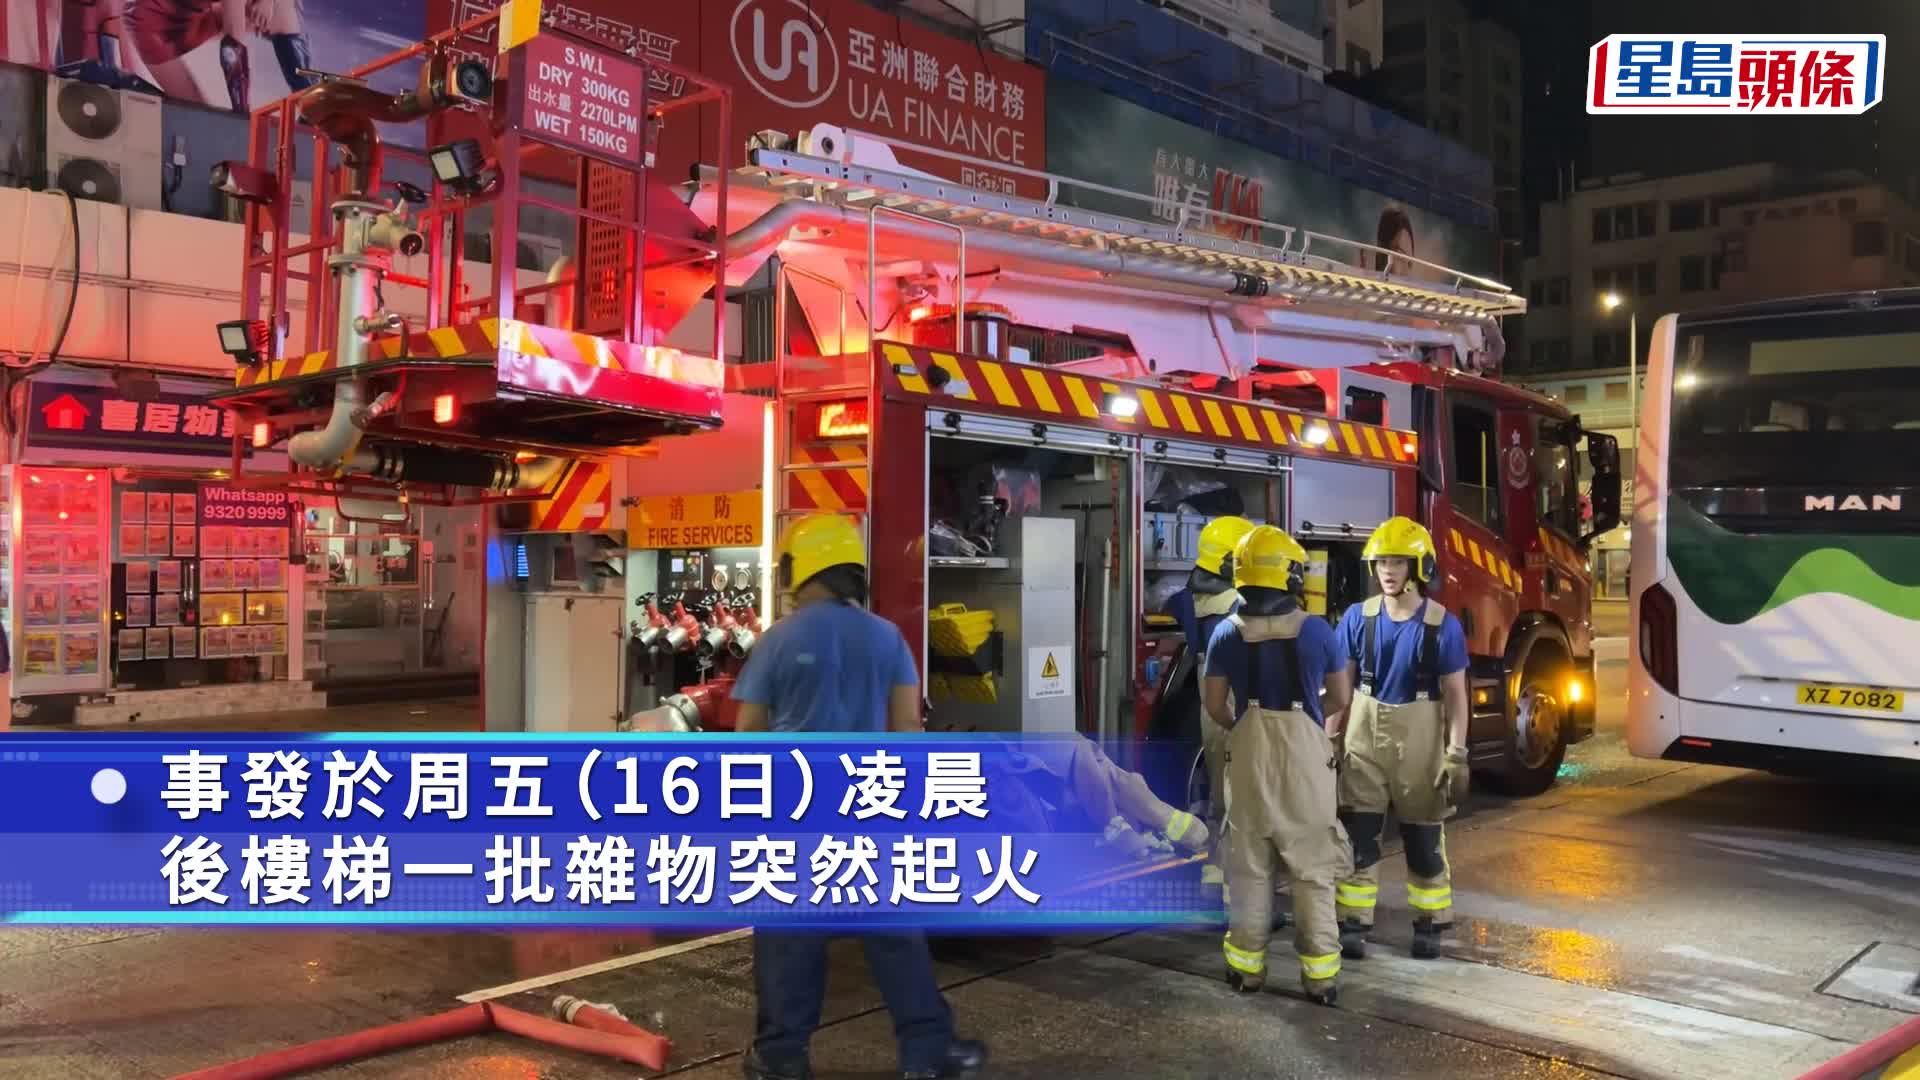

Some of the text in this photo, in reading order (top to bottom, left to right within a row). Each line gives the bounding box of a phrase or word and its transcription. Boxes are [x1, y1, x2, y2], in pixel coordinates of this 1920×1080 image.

[564, 47, 608, 77] S.W.L
[848, 28, 1025, 121] 亞洲聯合財務
[539, 62, 573, 87] DRY
[581, 77, 630, 107] 300KG
[528, 83, 637, 134] 出水量 2270LPM
[848, 78, 1025, 166] UA FINANCE
[535, 109, 628, 153] WET 150KG
[205, 487, 285, 505] Whatsapp
[1805, 495, 1901, 512] MAN
[205, 505, 287, 520] 9320 9999
[648, 524, 753, 546] FIRE SERVICES
[1805, 687, 1896, 709] XZ 7082
